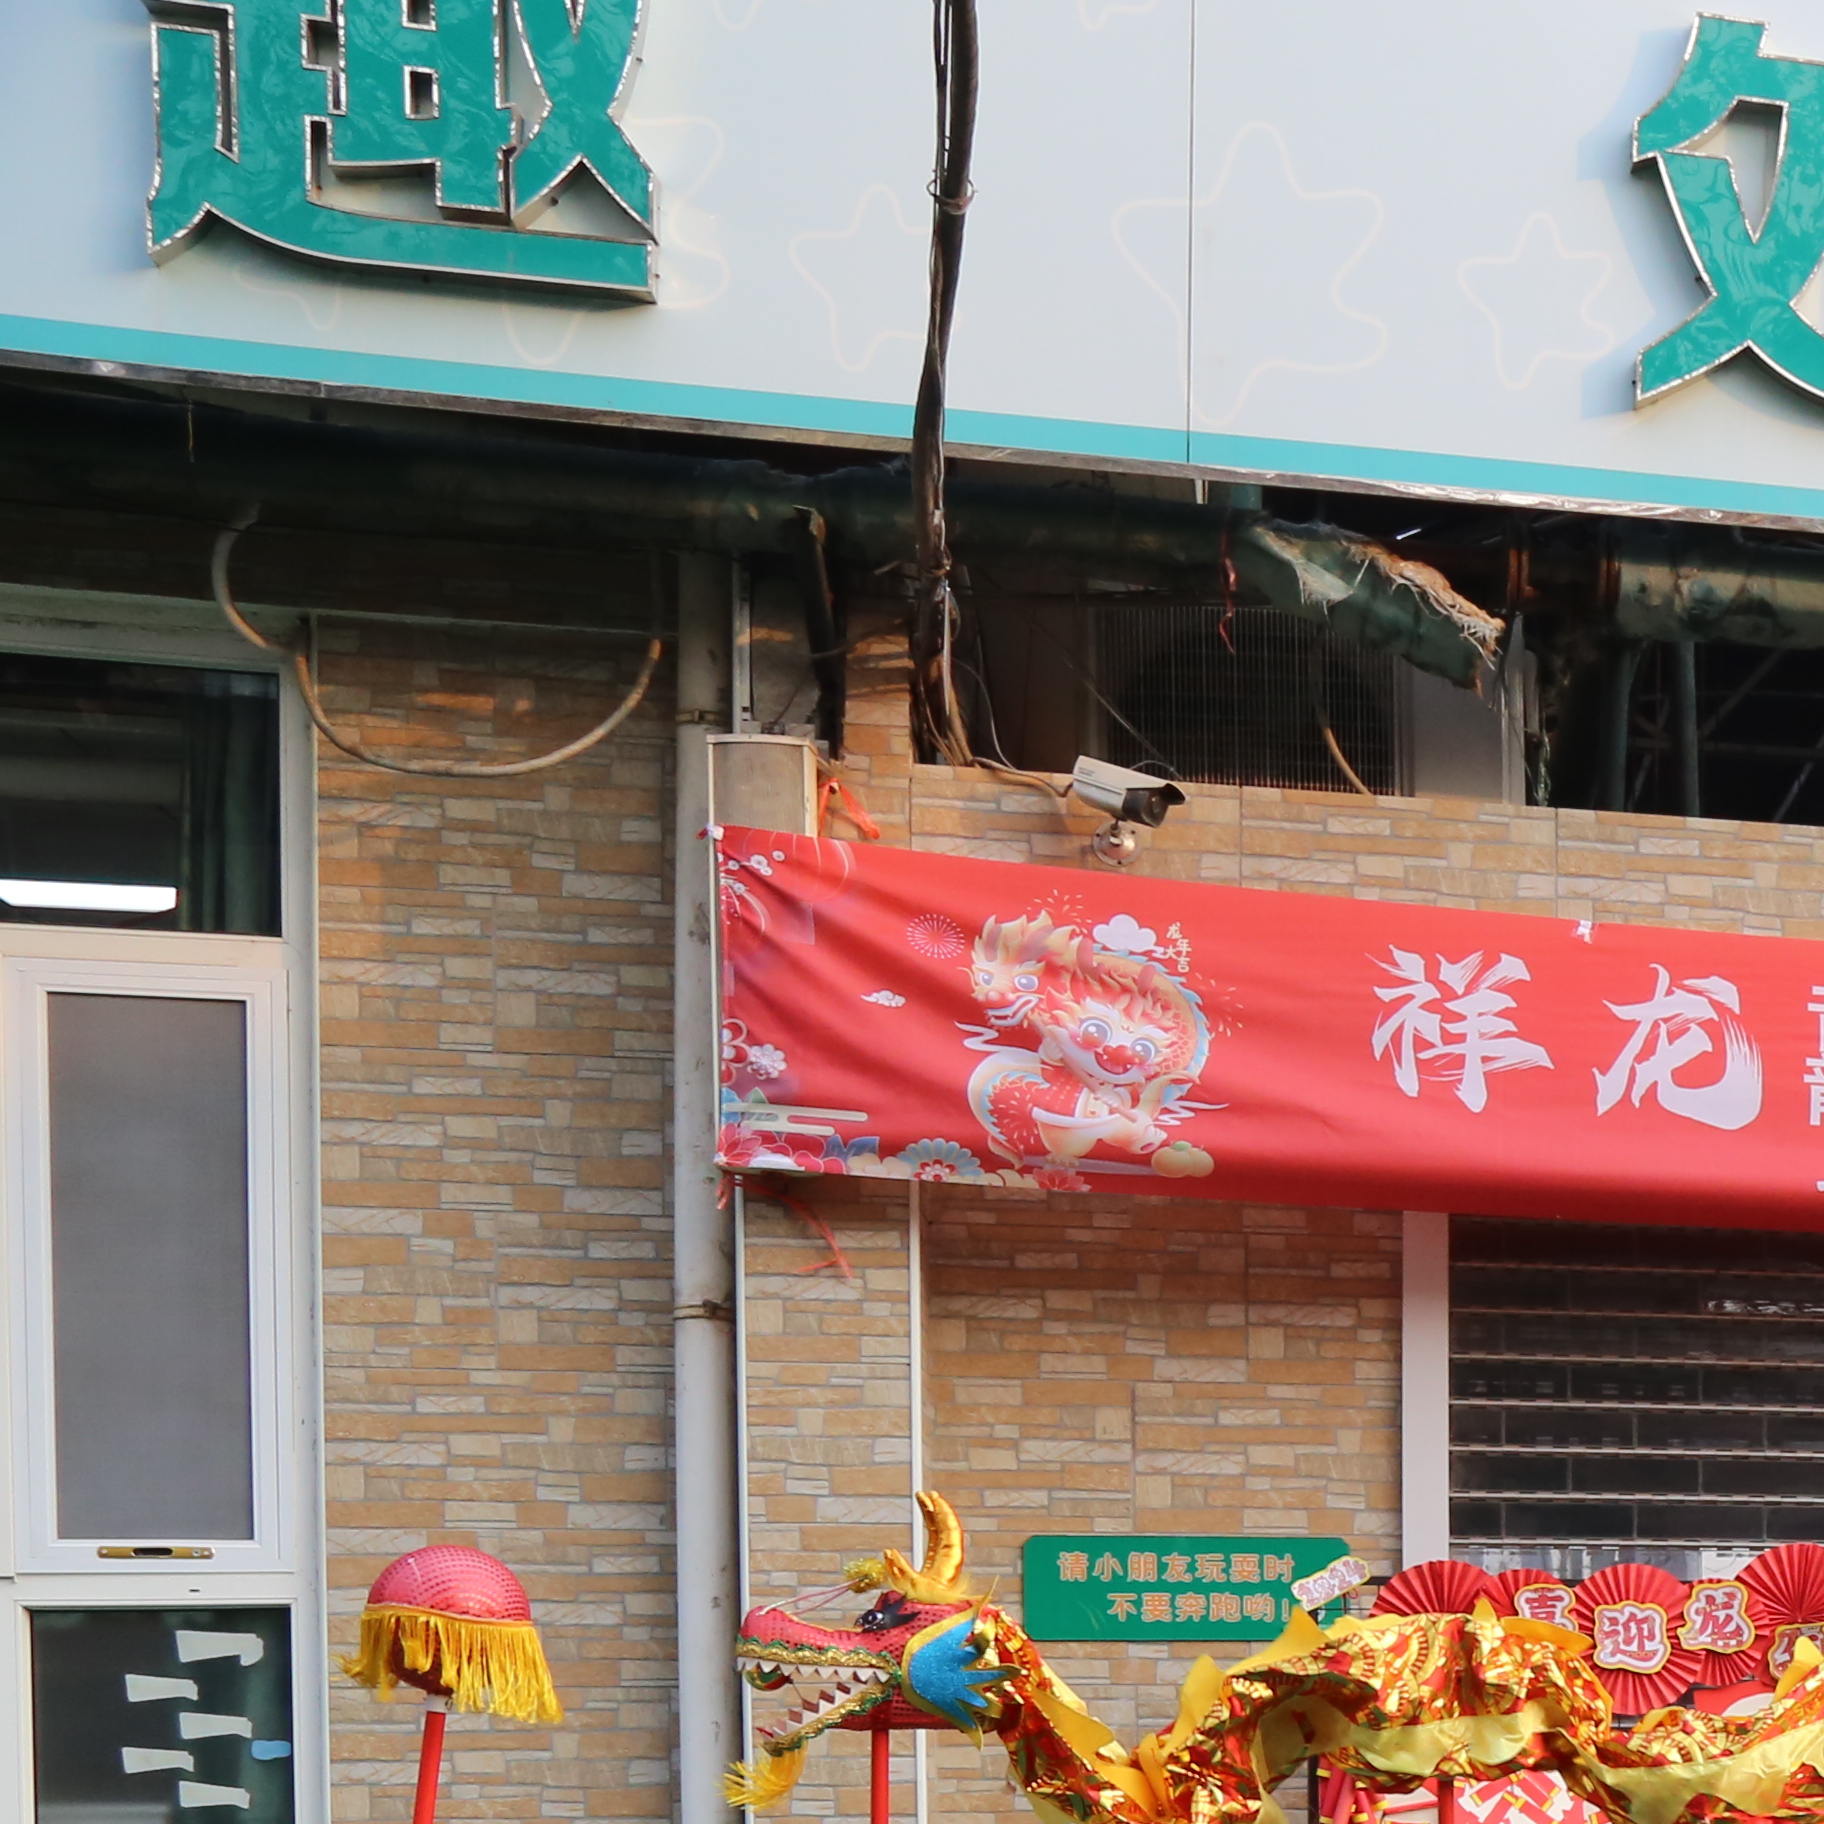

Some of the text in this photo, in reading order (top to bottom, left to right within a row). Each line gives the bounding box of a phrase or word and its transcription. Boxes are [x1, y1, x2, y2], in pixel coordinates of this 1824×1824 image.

[1056, 1550, 1296, 1584] 请小朋友玩耍时
